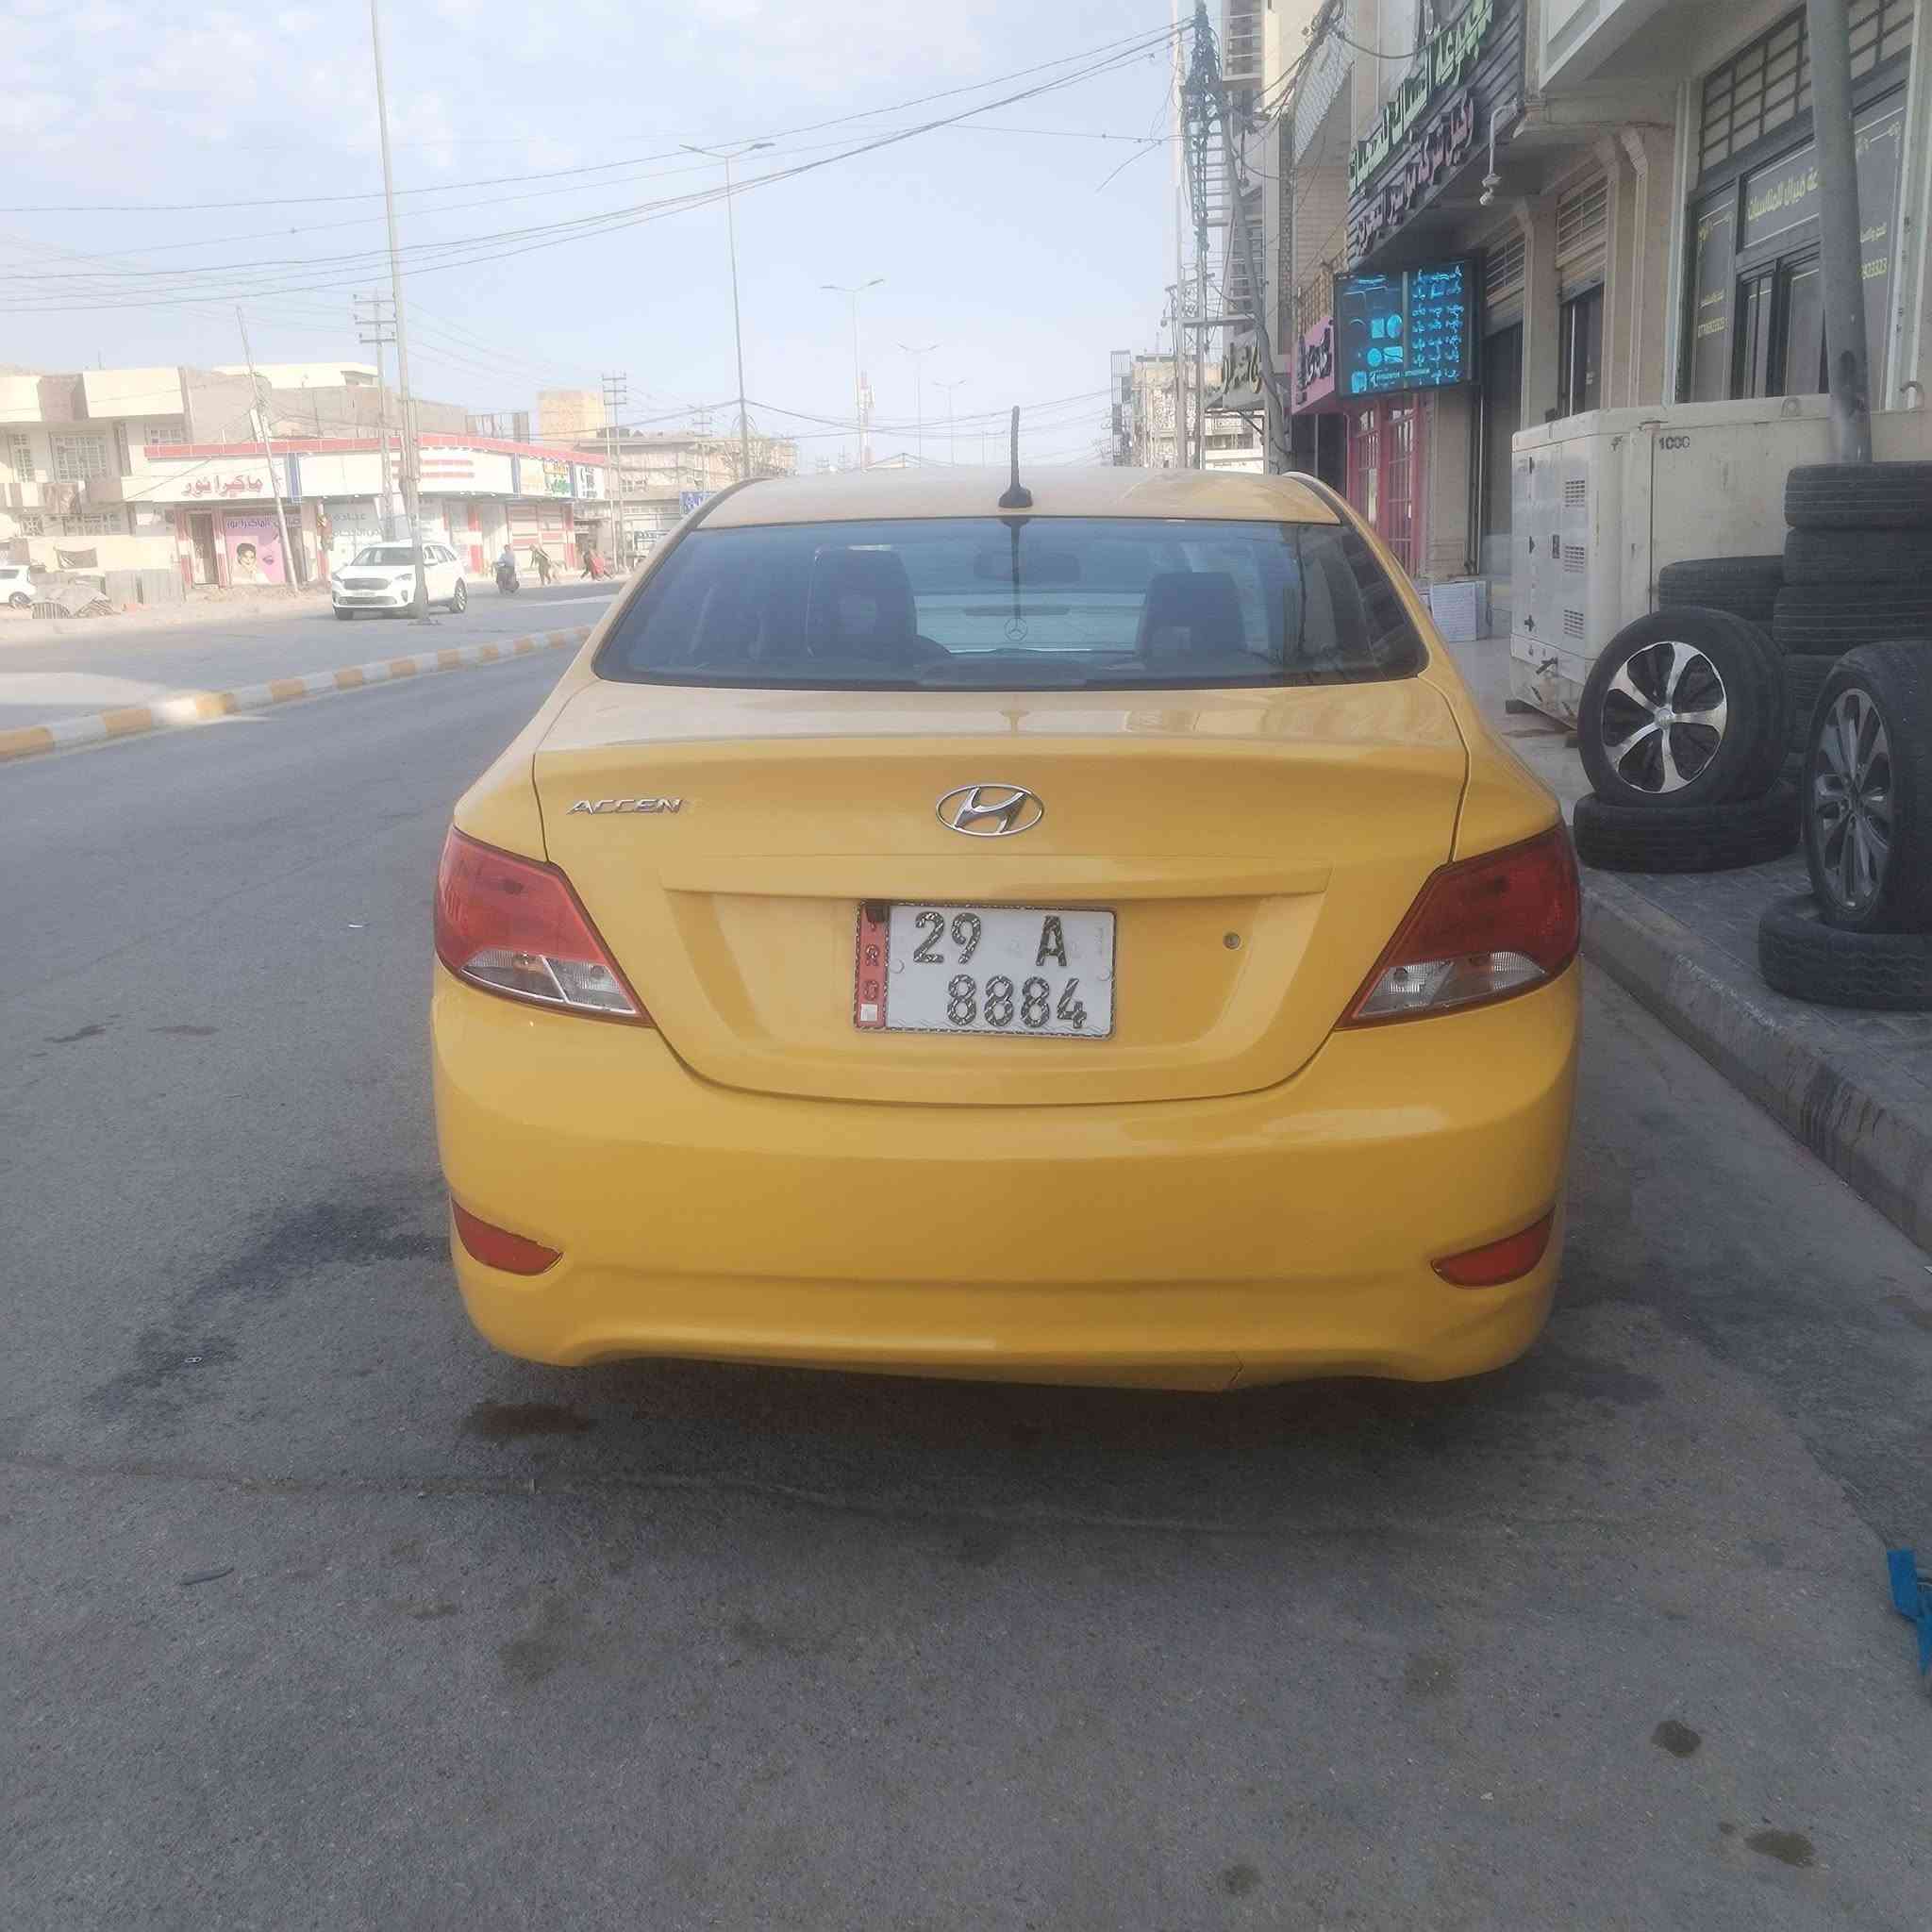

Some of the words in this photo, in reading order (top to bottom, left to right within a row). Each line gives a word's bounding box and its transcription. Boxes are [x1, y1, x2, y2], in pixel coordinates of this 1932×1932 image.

[566, 799, 682, 815] ACCEN
[913, 911, 982, 965] 29
[1035, 915, 1068, 967] A
[946, 974, 1088, 1029] 8884
